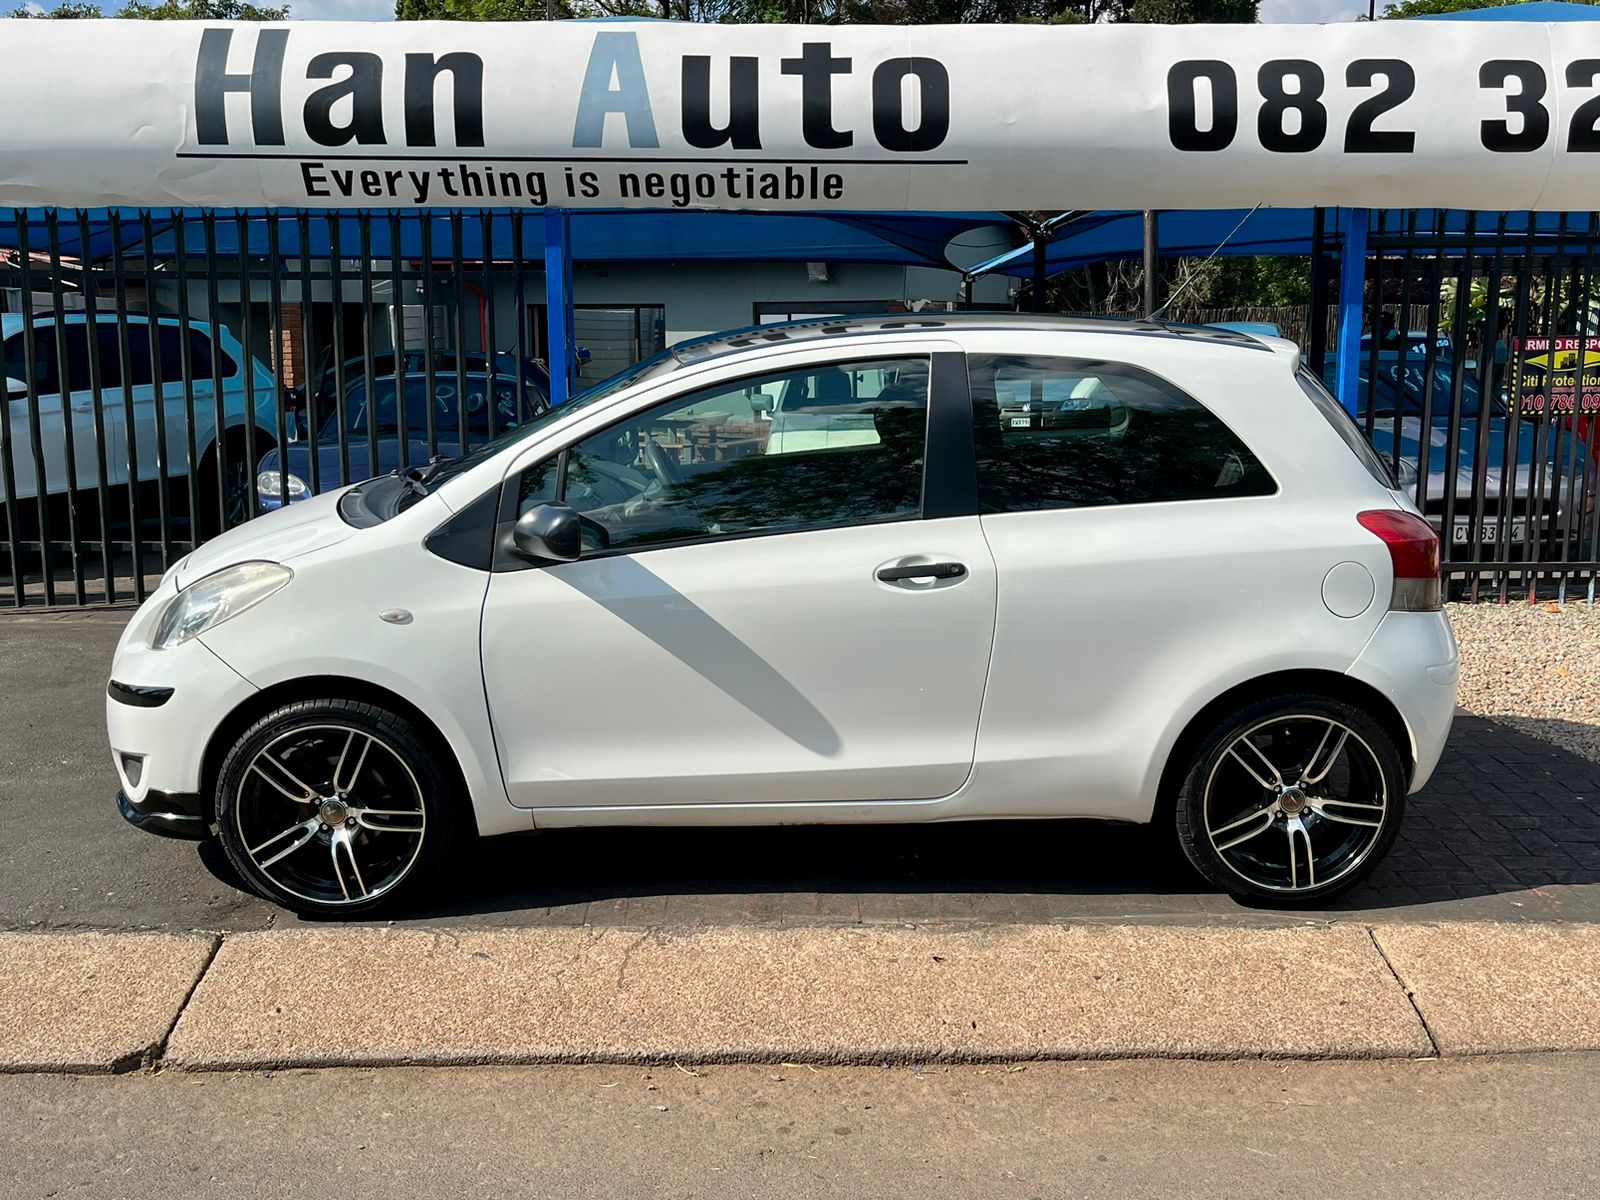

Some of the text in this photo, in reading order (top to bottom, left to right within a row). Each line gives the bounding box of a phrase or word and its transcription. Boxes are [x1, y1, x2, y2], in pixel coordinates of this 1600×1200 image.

[195, 28, 950, 151] Han Auto
[1167, 58, 1415, 153] 082
[300, 162, 844, 207] Everything is negotiable
[1525, 340, 1562, 350] RMED
[1542, 374, 1600, 386] Protetio
